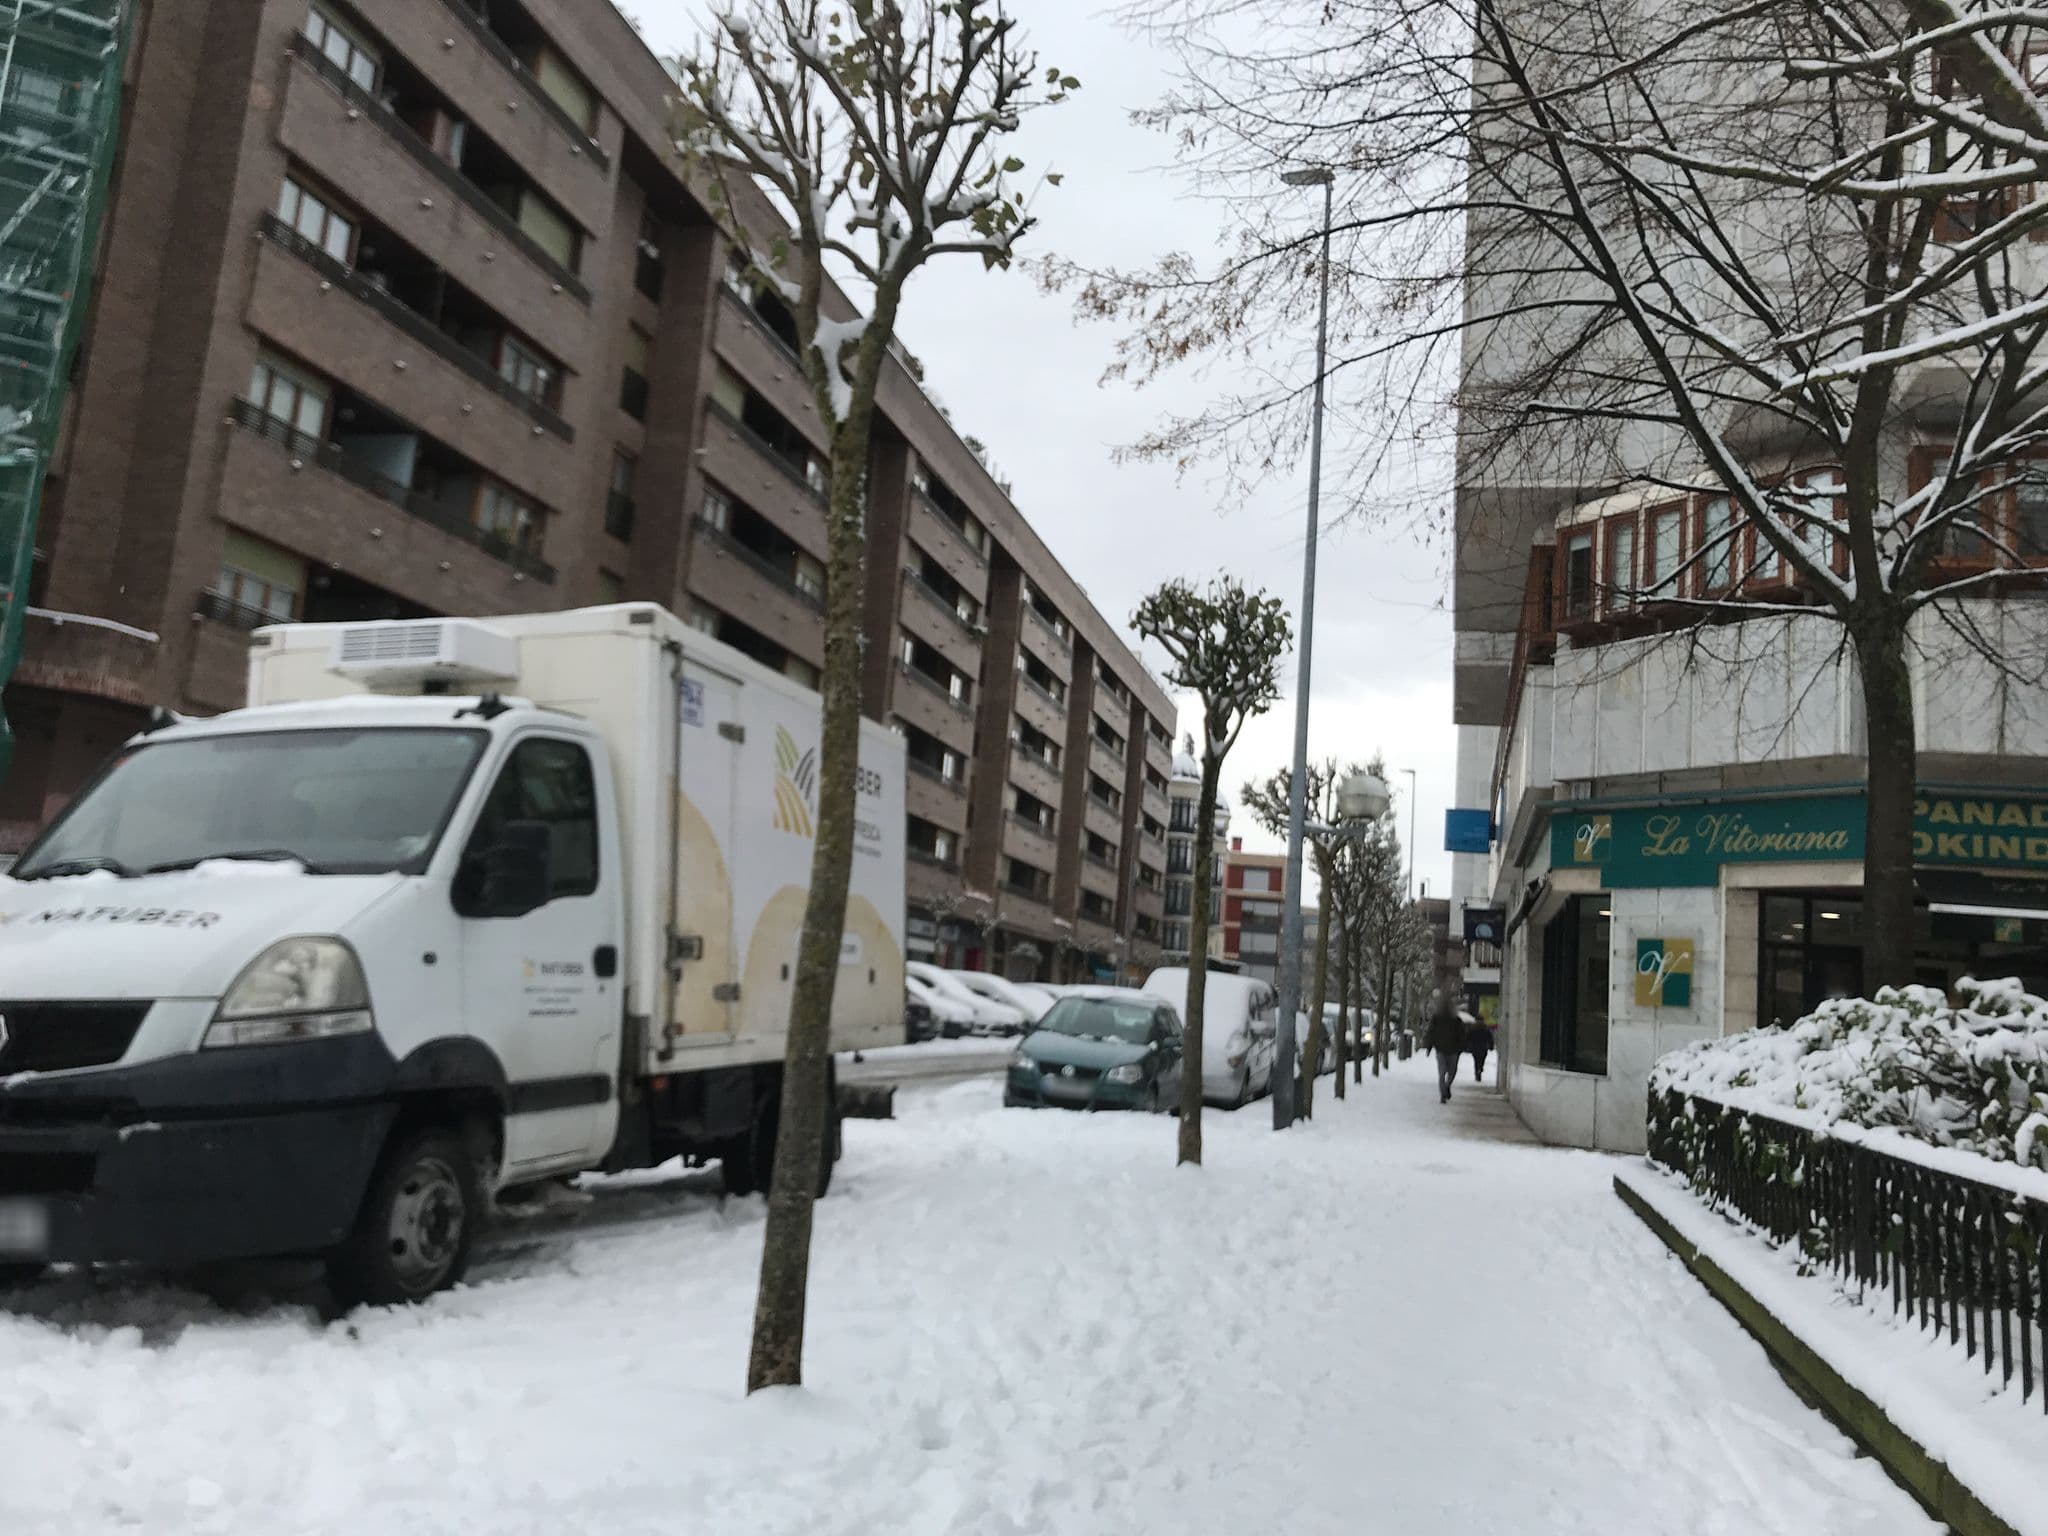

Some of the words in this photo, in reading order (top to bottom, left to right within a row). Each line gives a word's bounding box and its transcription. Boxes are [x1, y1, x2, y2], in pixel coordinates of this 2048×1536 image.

[857, 767, 881, 797] BER
[1641, 815, 1690, 857] La
[1696, 813, 1848, 855] Vitoriana
[32, 906, 221, 928] NATUBER
